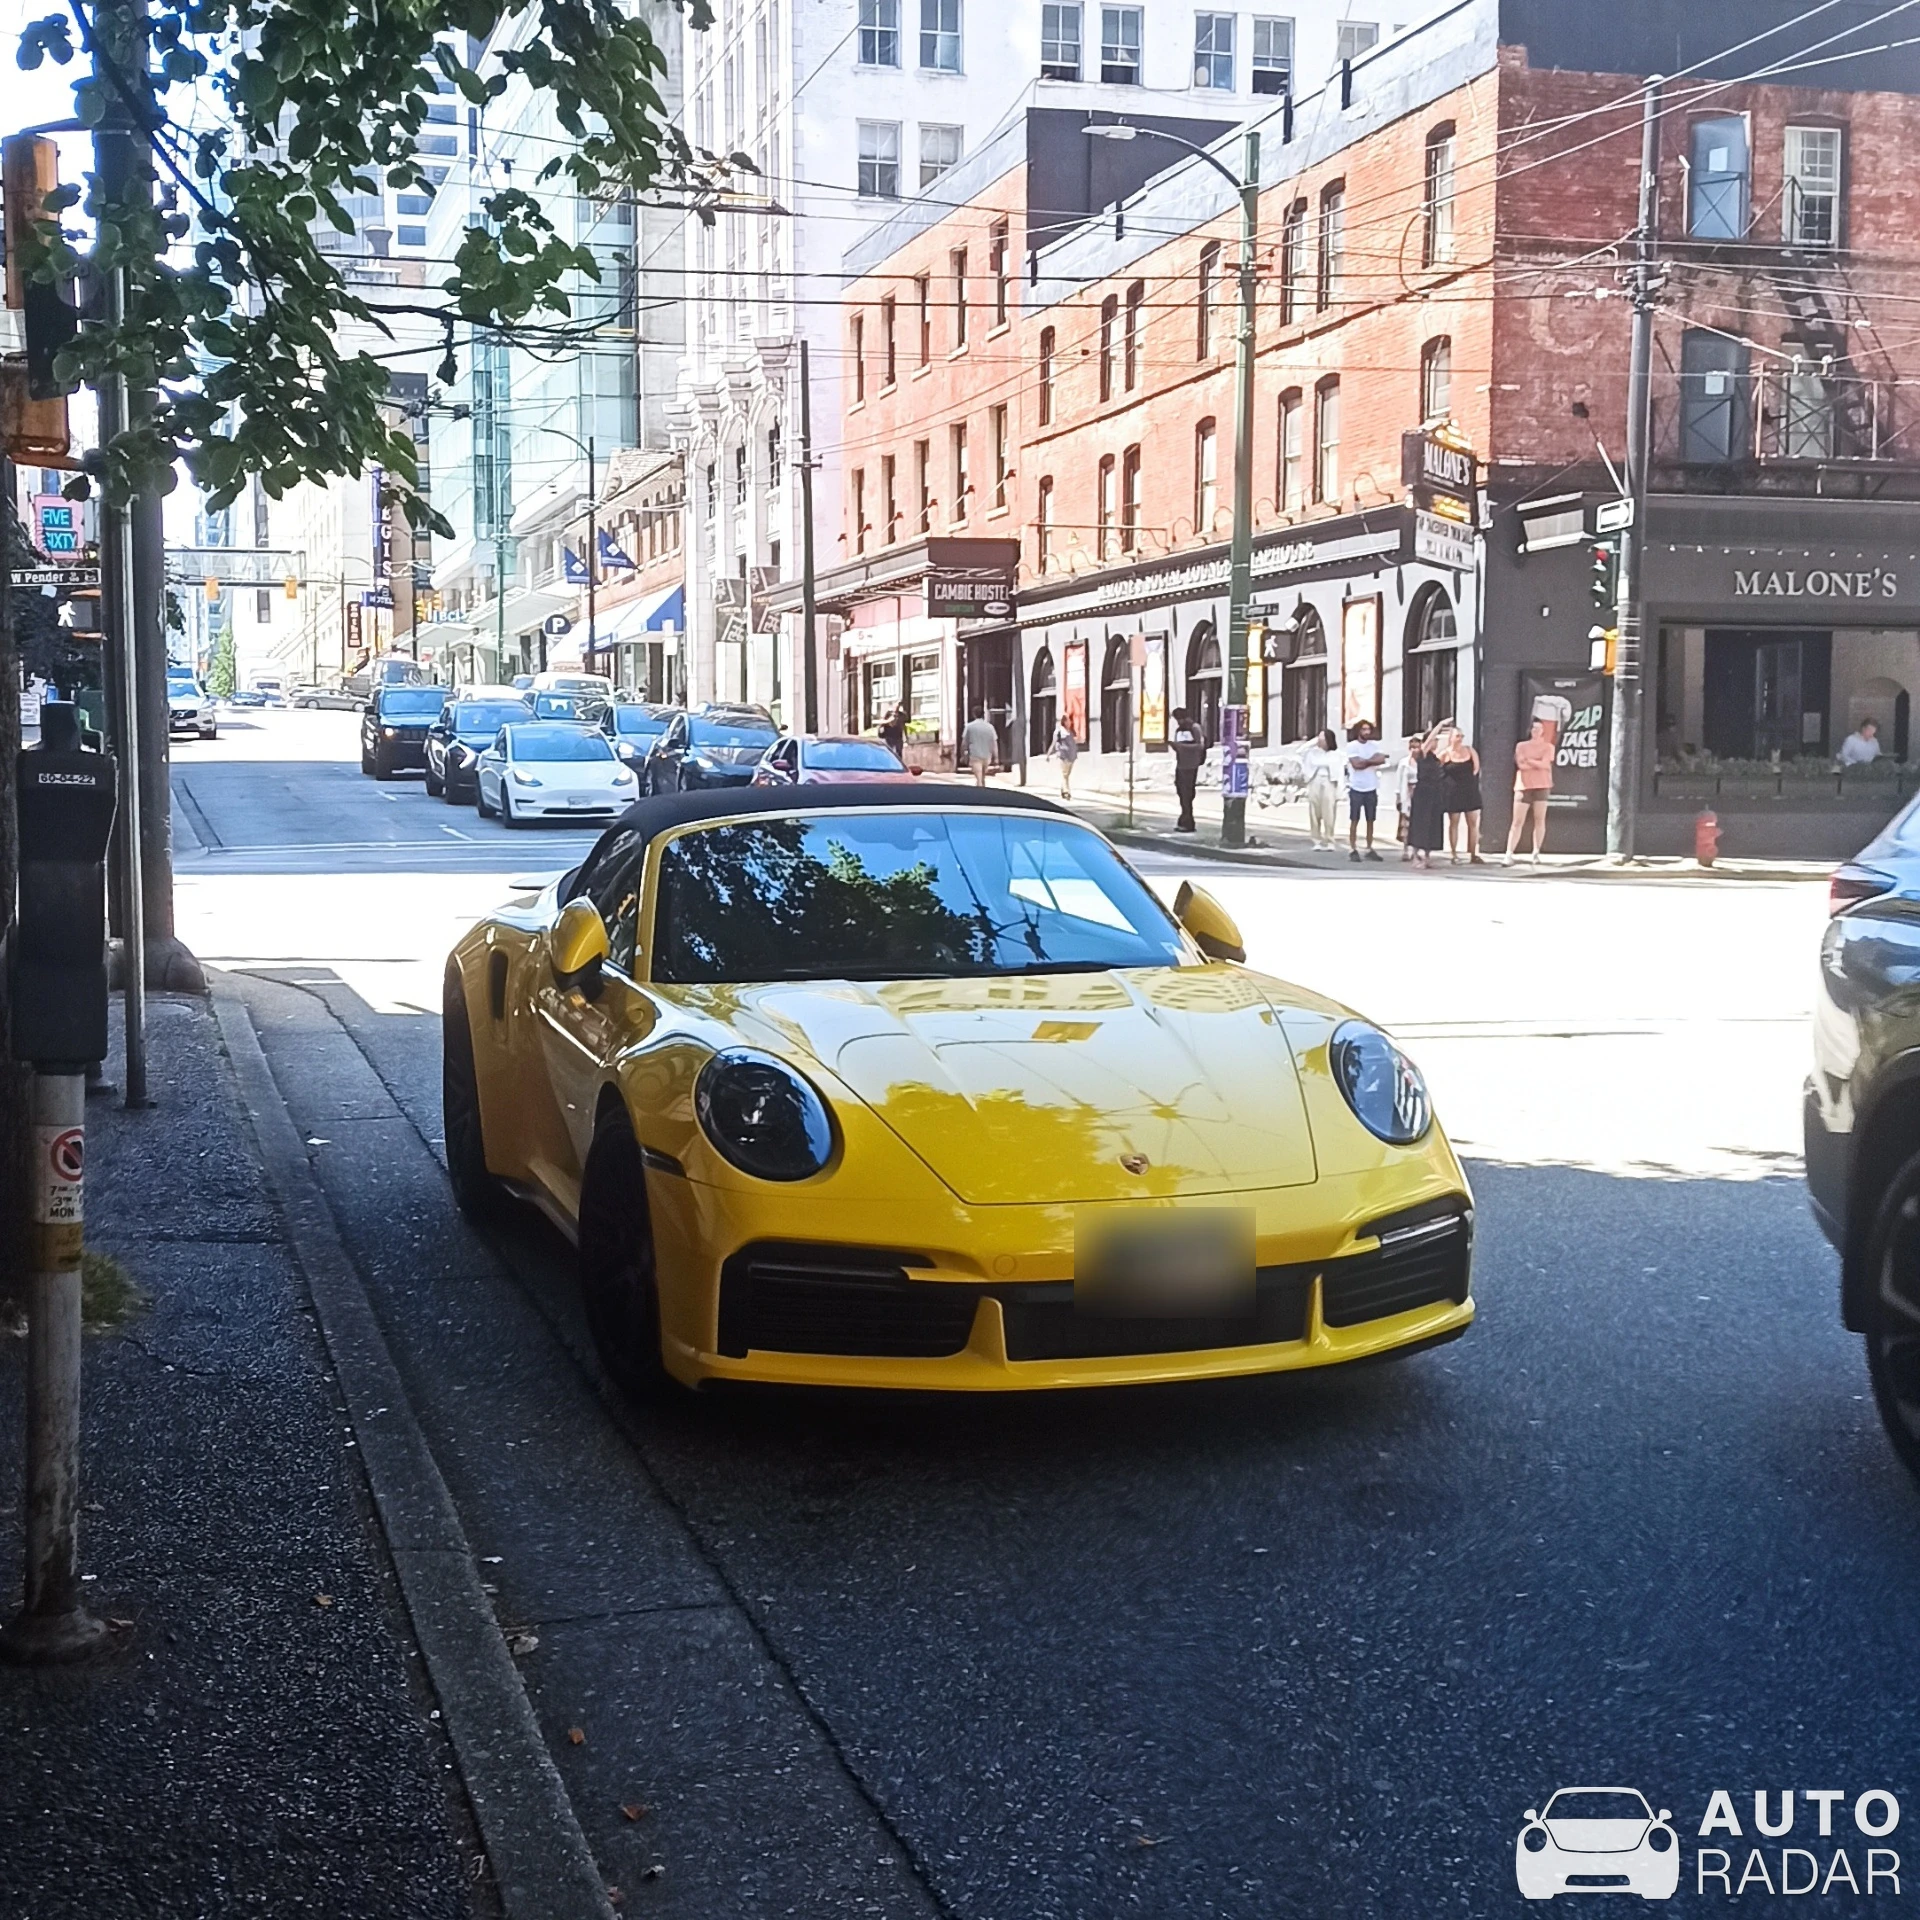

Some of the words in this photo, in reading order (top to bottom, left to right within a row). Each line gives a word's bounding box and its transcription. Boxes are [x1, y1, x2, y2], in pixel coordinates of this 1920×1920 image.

[1424, 441, 1471, 486] MALONE'S
[42, 508, 70, 525] FIVE
[381, 487, 393, 577] EGIS
[11, 573, 21, 583] W
[25, 572, 64, 583] Pender
[1734, 567, 1897, 597] MALONE'S
[934, 584, 973, 600] CAMBIE
[975, 584, 1009, 600] HOSTEL
[553, 618, 565, 632] P
[1567, 705, 1602, 730] TAP
[1561, 729, 1598, 748] TAKE
[1556, 748, 1597, 767] OVER
